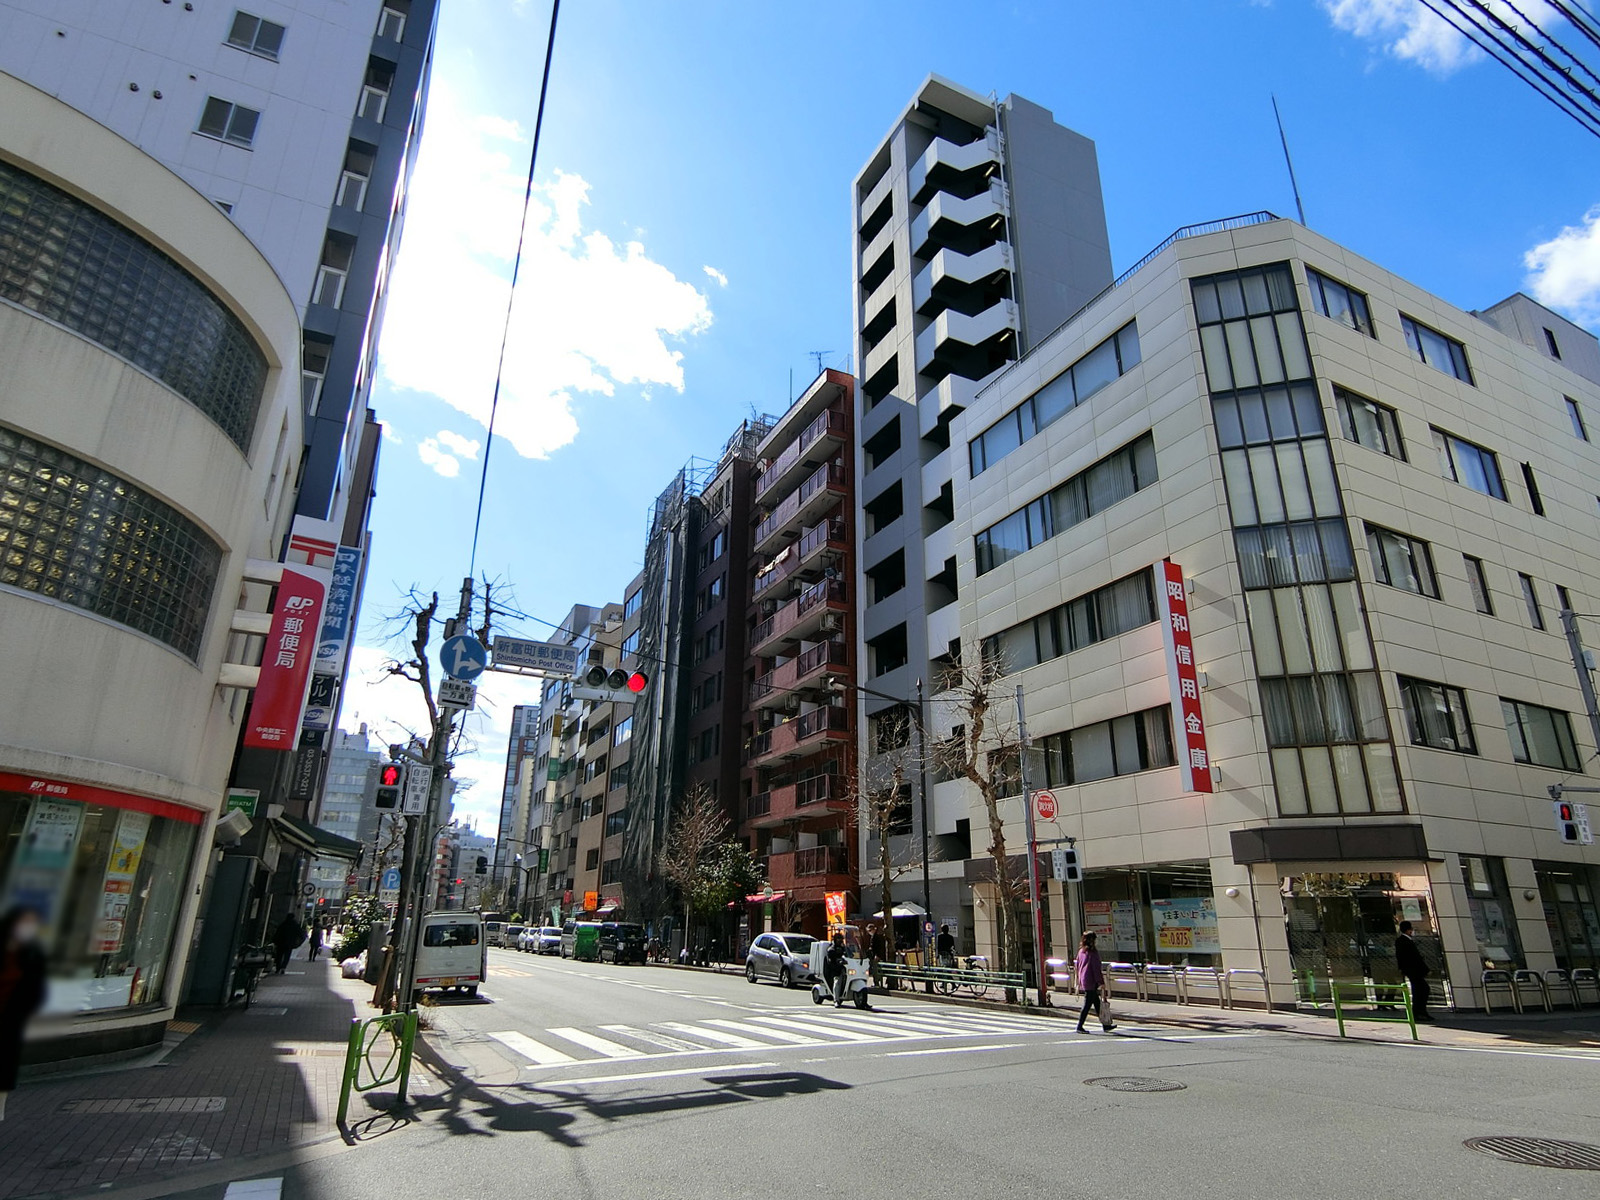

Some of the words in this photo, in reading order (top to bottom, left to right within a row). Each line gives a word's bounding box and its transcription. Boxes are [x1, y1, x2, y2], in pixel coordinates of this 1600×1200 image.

[274, 617, 304, 669] 郵便局
[496, 640, 576, 662] 新富町郵便局
[496, 653, 537, 665] Shintomicho
[539, 659, 552, 667] Post
[555, 662, 574, 670] Office
[1166, 580, 1208, 770] 昭和信用金庫
[441, 691, 473, 701] 一方通行
[261, 733, 281, 741] 郵便局
[411, 768, 420, 793] 自転車
[420, 769, 429, 794] 歩行者
[1039, 801, 1054, 812] 消火栓
[387, 873, 397, 887] P
[1162, 909, 1208, 920] 住まい上手
